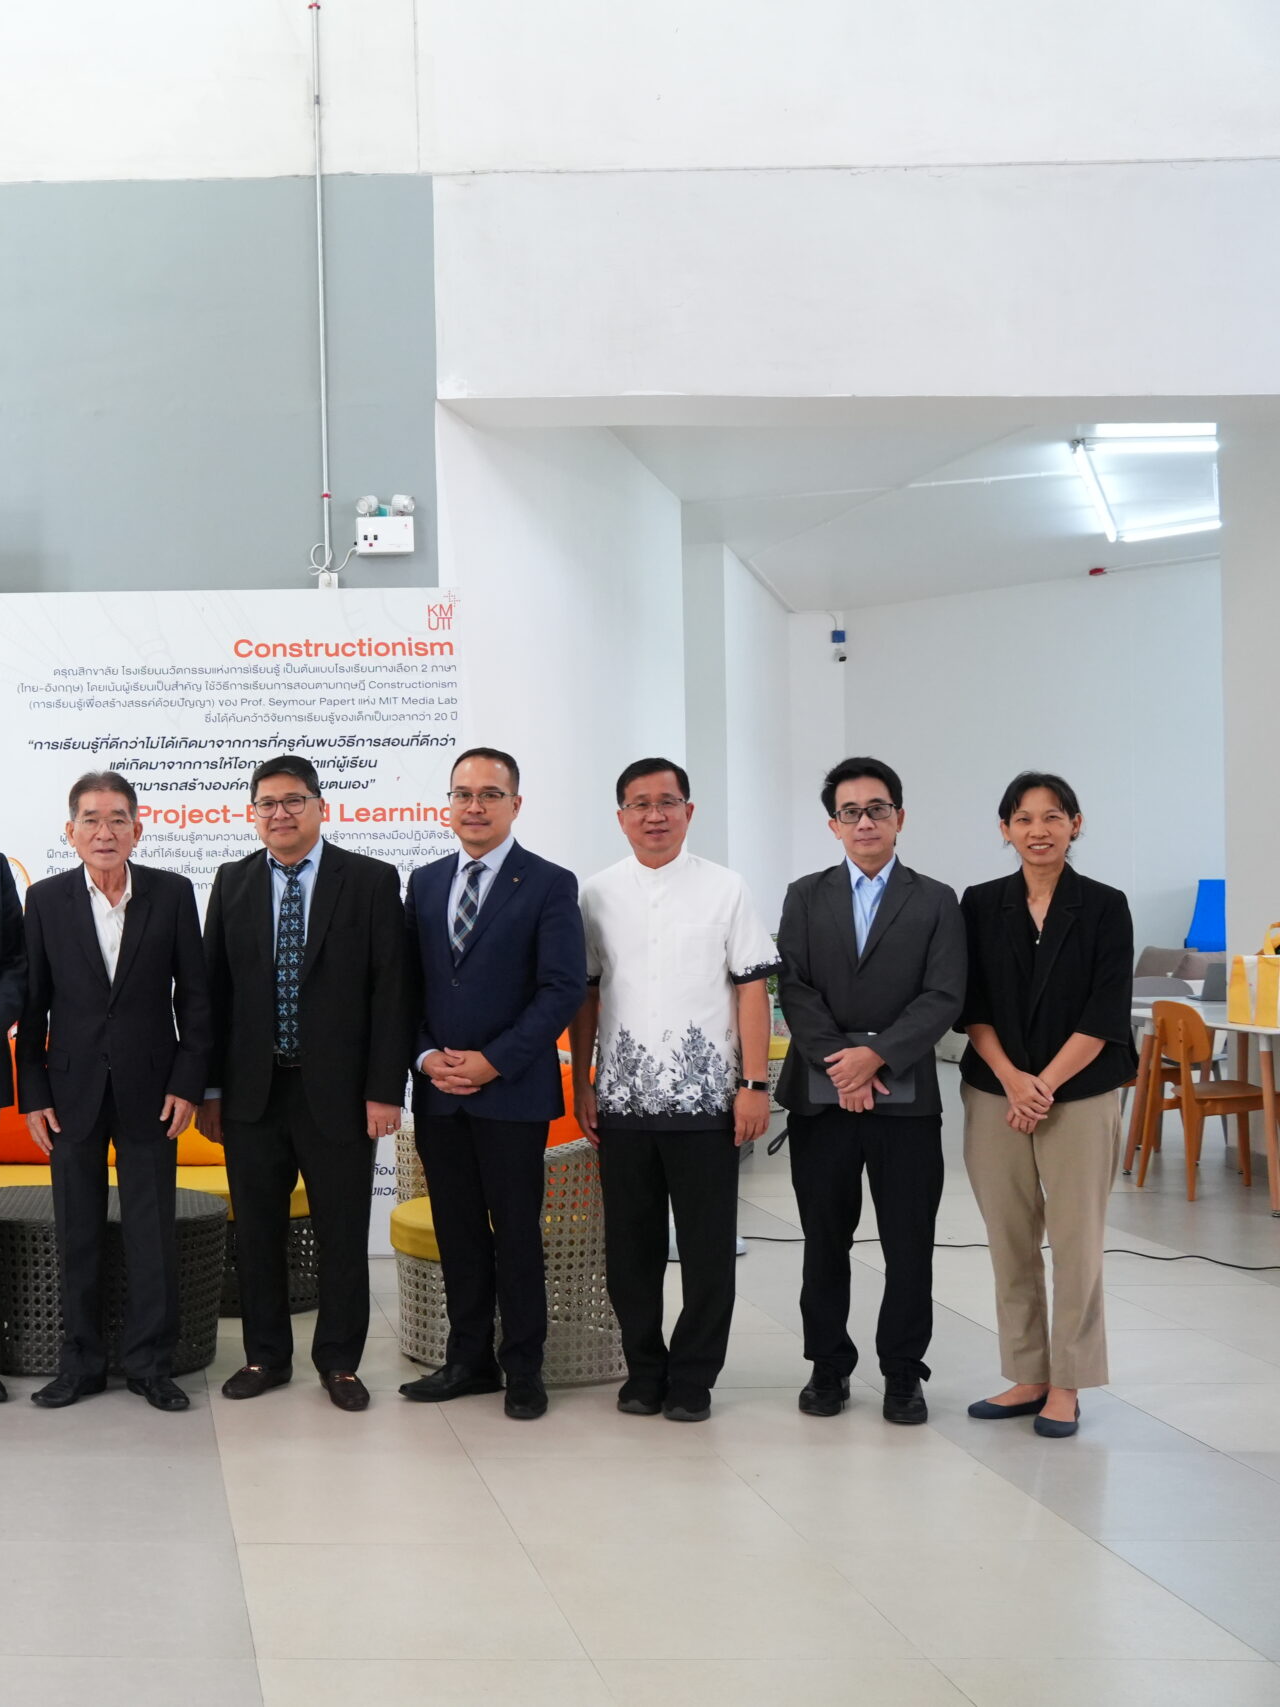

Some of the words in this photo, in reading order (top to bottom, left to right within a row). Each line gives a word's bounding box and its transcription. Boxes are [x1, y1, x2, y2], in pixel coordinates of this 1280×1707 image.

[233, 637, 454, 658] Constructionism
[421, 664, 428, 673] 2
[431, 663, 457, 673] ภาษา
[368, 680, 458, 690] Constructionism
[219, 698, 238, 708] ของ
[240, 698, 266, 707] Prof.
[268, 697, 317, 709] Seymour
[319, 697, 355, 708] Papert
[379, 696, 399, 705] MIT
[401, 696, 435, 705] Media
[437, 696, 458, 705] Lab
[434, 712, 447, 721] 20
[450, 711, 458, 721] ปี
[339, 802, 452, 828] Learning
